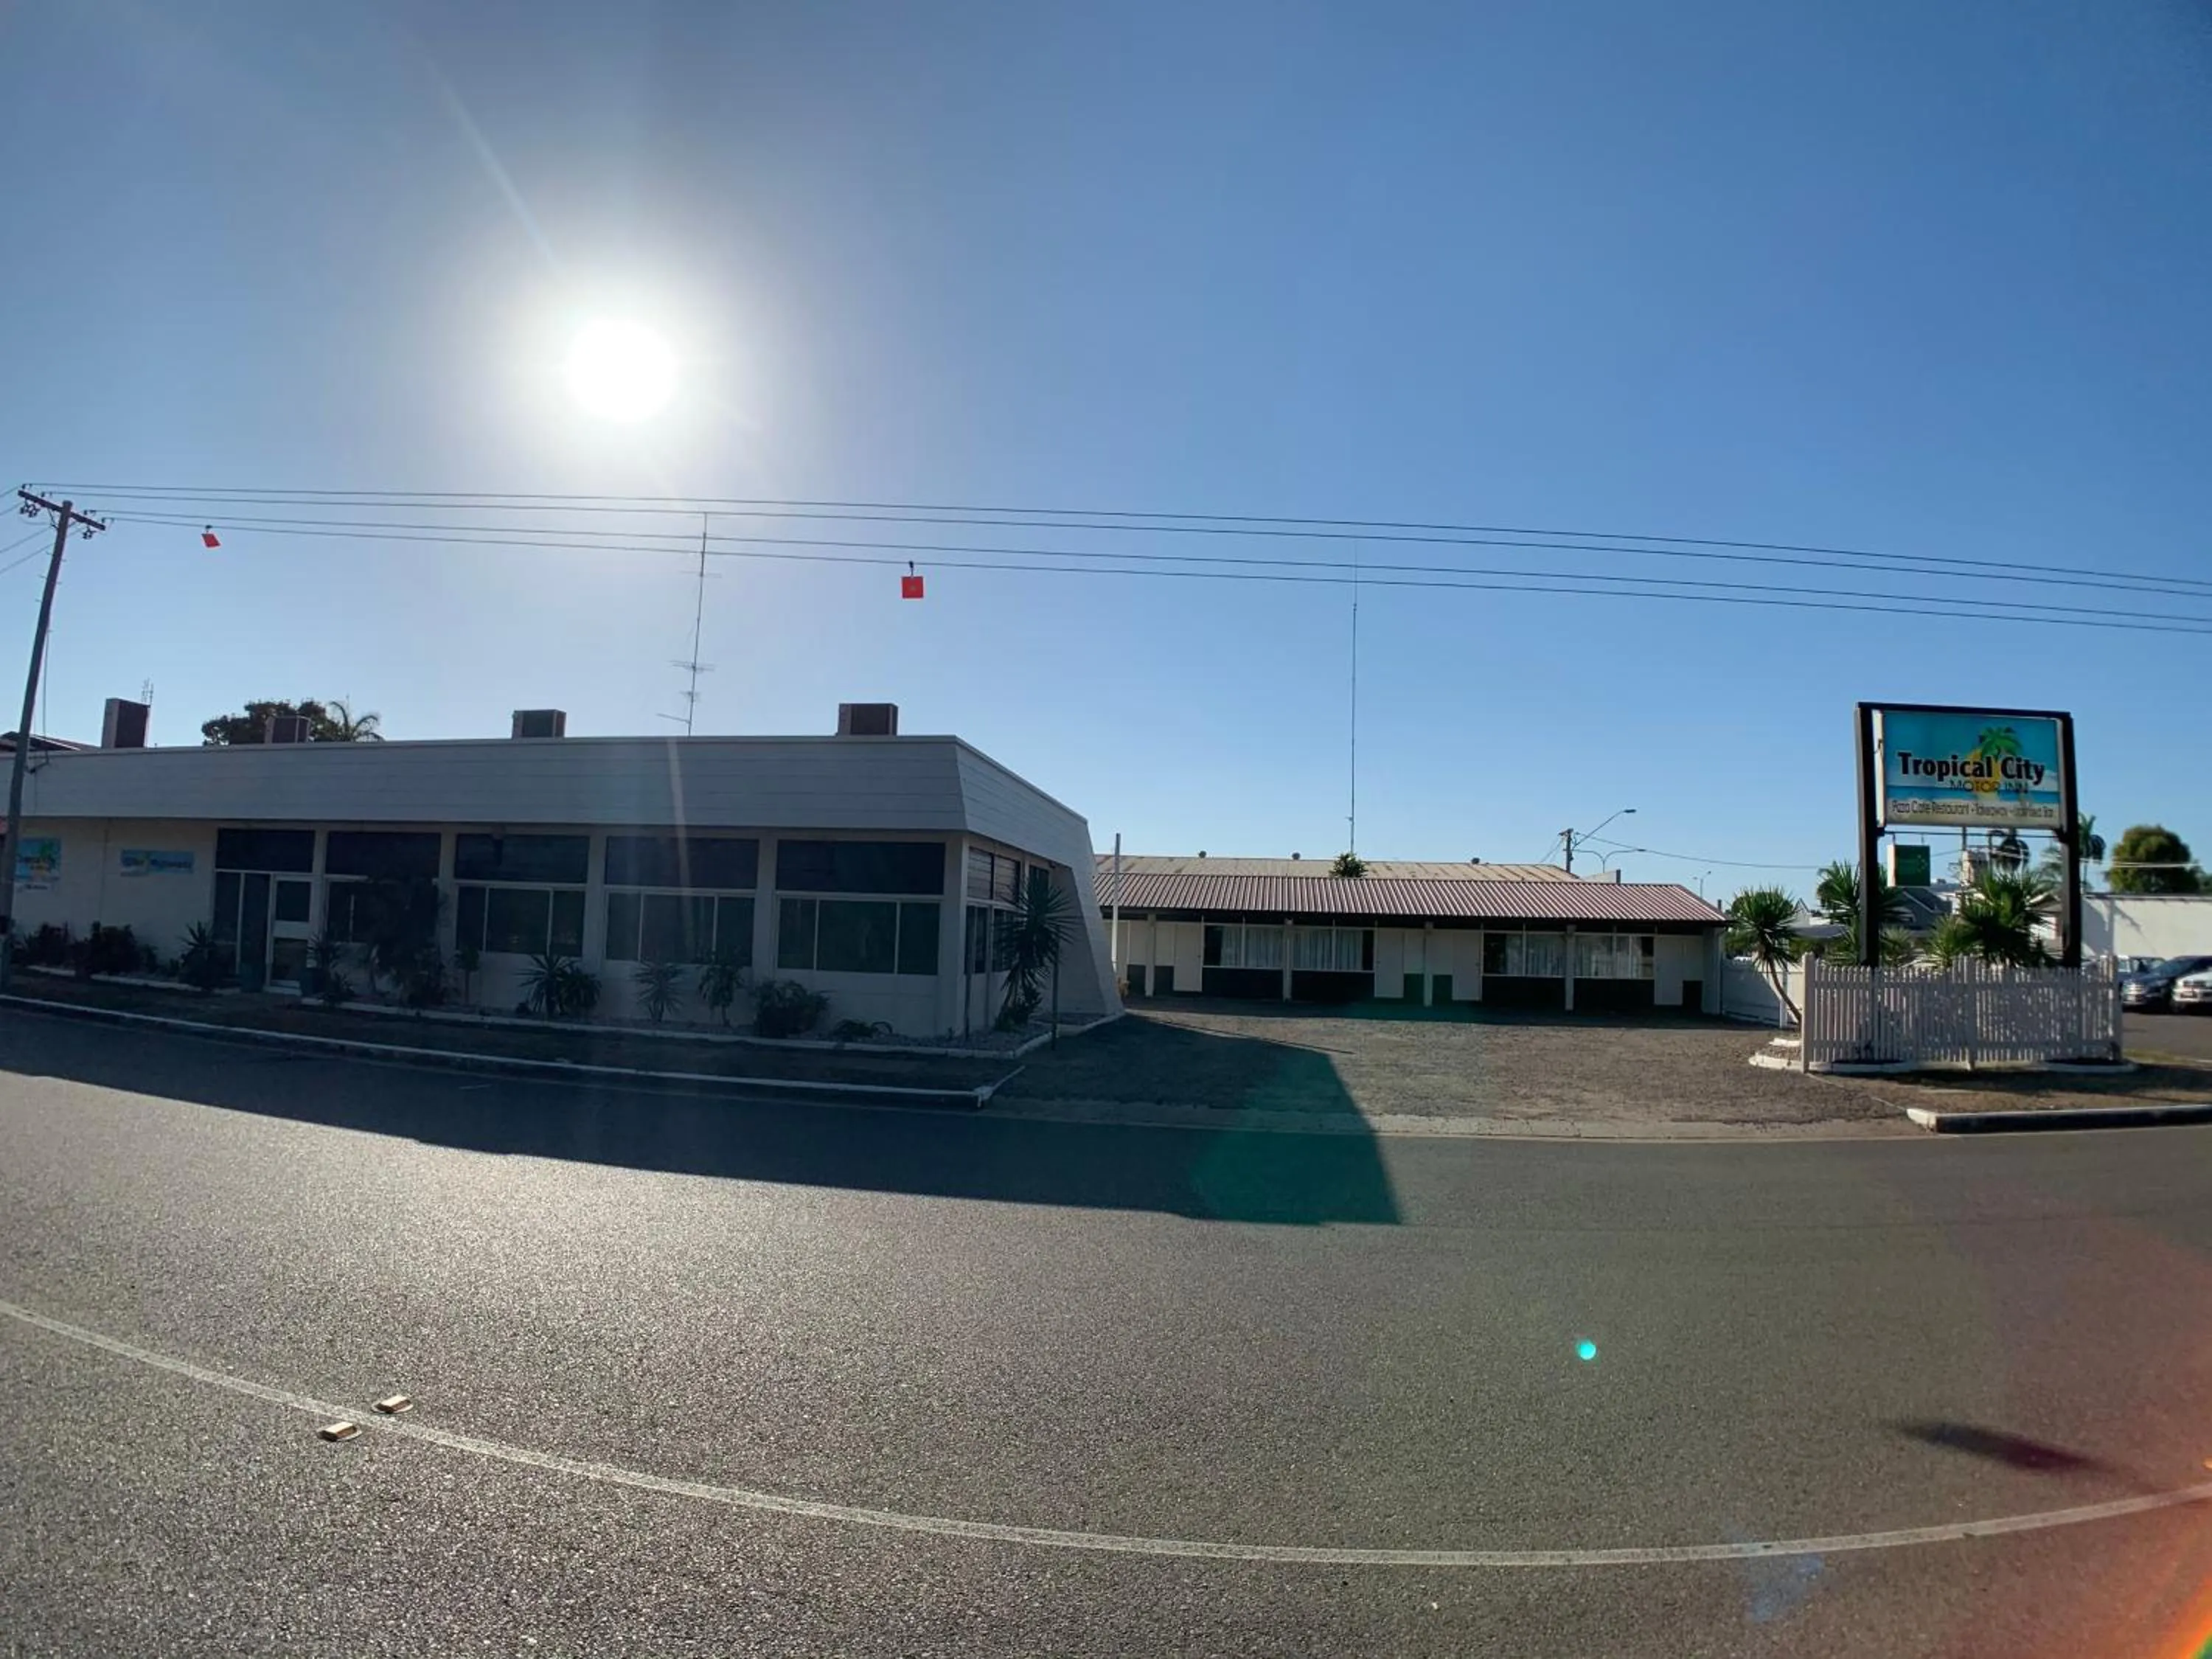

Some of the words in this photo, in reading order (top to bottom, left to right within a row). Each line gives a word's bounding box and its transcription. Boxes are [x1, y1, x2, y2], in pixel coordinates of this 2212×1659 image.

[1897, 751, 1993, 782] Tropical
[2000, 756, 2046, 785] City
[1949, 779, 2000, 793] MOTOR
